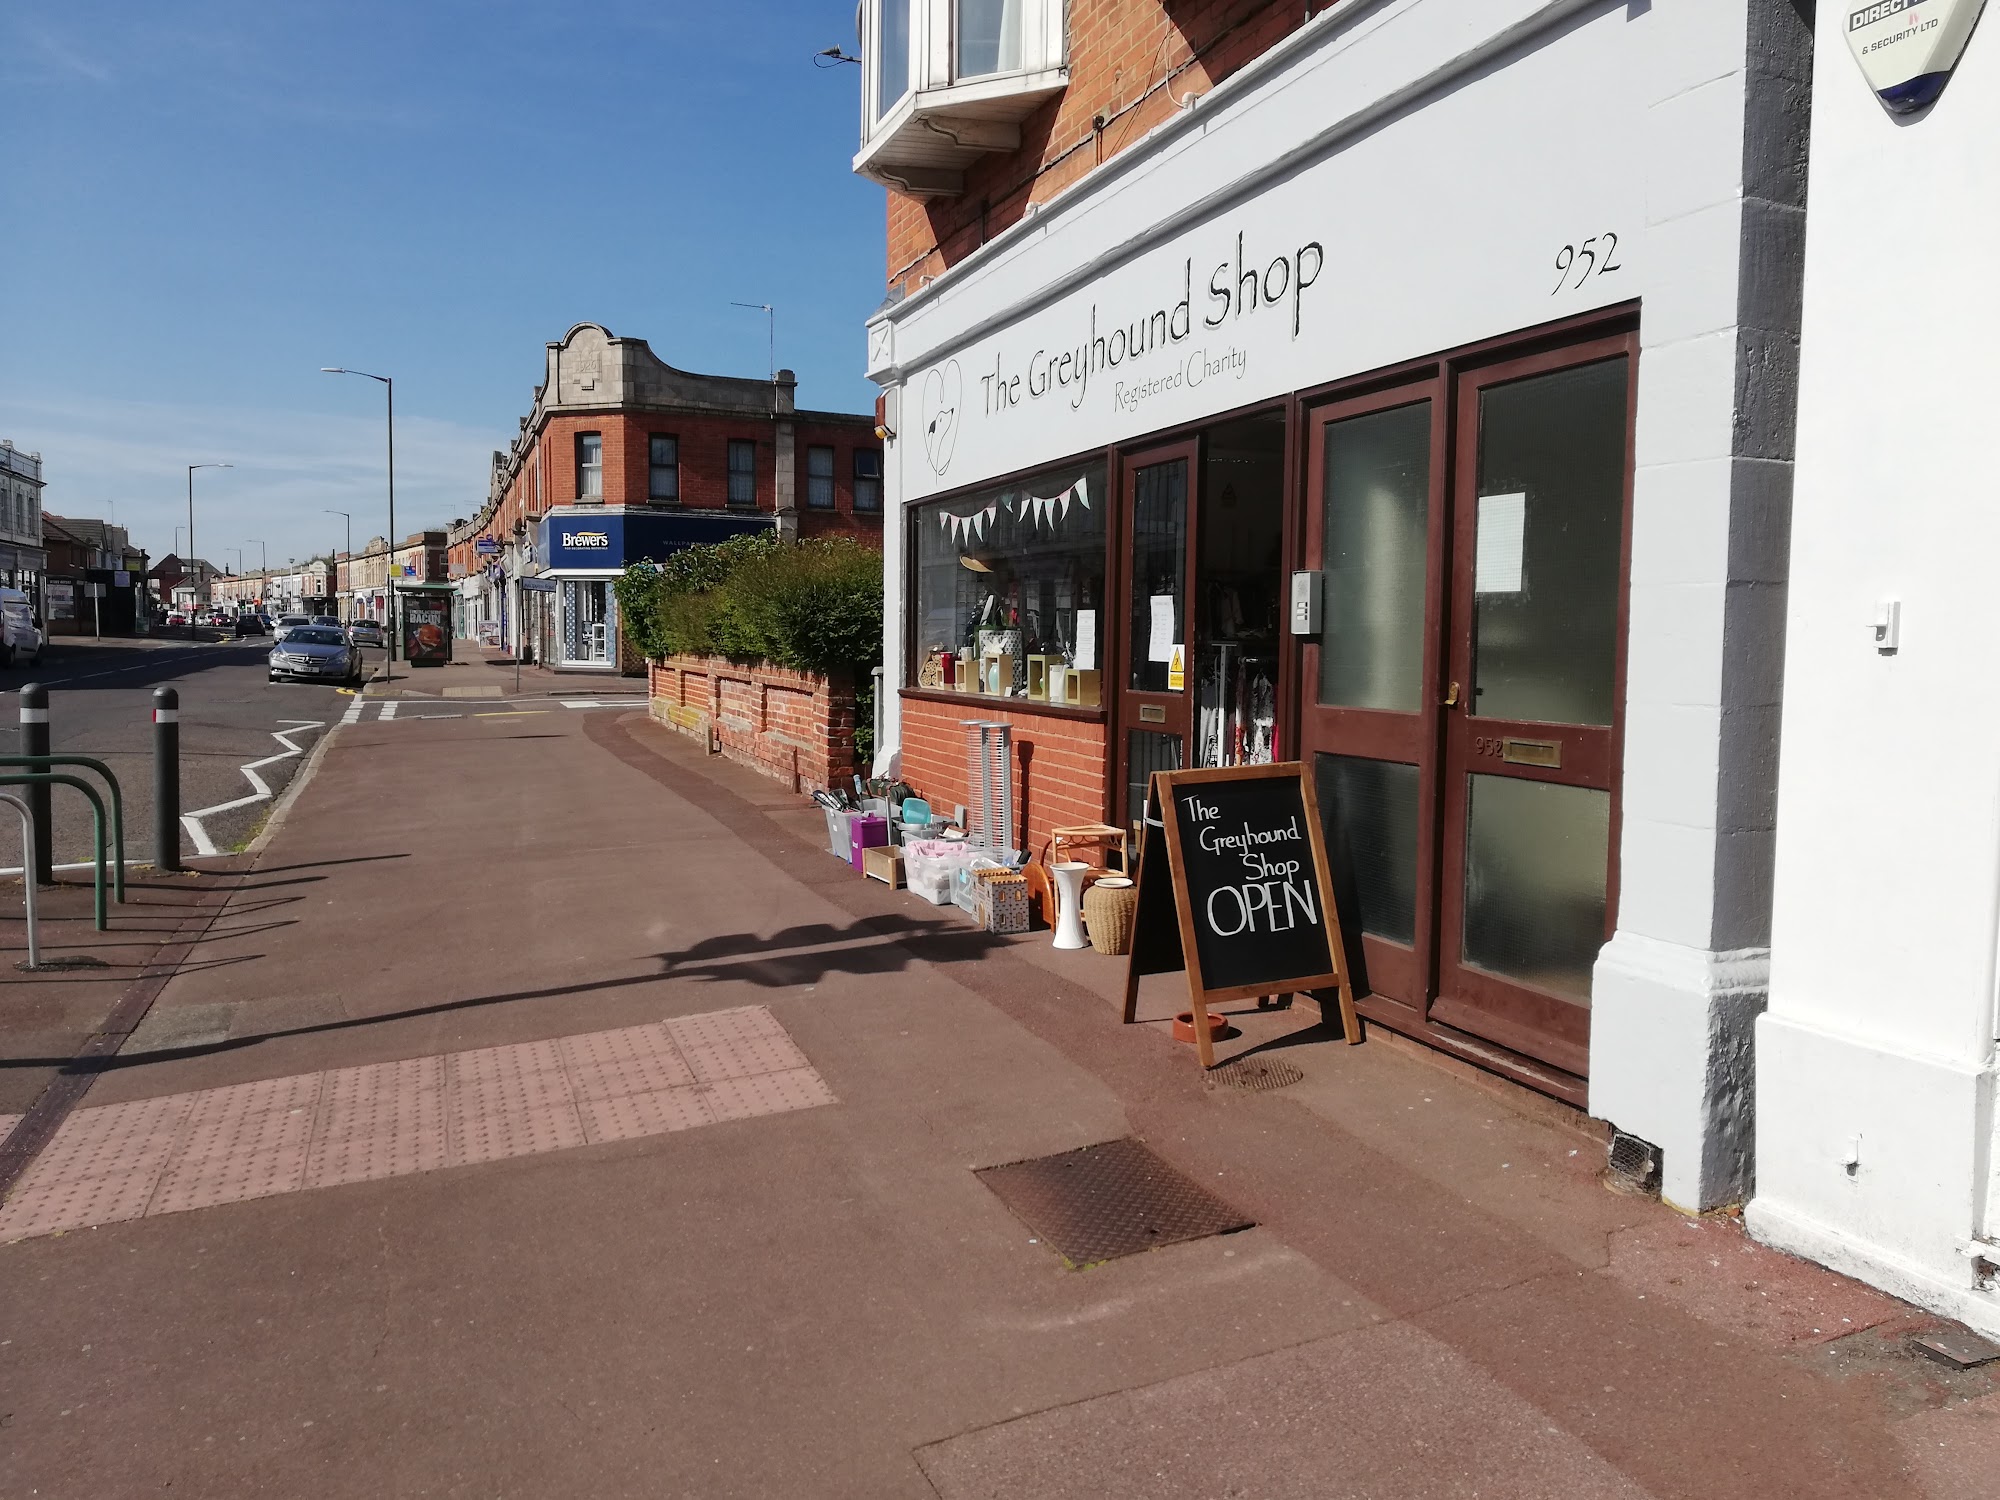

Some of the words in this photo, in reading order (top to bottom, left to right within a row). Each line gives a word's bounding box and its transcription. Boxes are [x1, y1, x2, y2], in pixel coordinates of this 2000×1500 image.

[1862, 46, 1869, 55] &
[1871, 26, 1919, 51] SECURITY
[1920, 18, 1939, 32] LTD
[1550, 231, 1622, 296] 952
[981, 352, 1020, 415] The
[1029, 257, 1191, 409] Greyhound
[1204, 230, 1324, 337] Shop
[1114, 360, 1183, 412] Registered
[1186, 346, 1247, 388] Charity
[562, 532, 608, 547] Brewers
[1476, 736, 1504, 758] 952
[1181, 794, 1221, 822] The
[1199, 815, 1302, 857] Greyhound
[1242, 852, 1300, 885] Shop
[1207, 879, 1318, 937] OPEN
